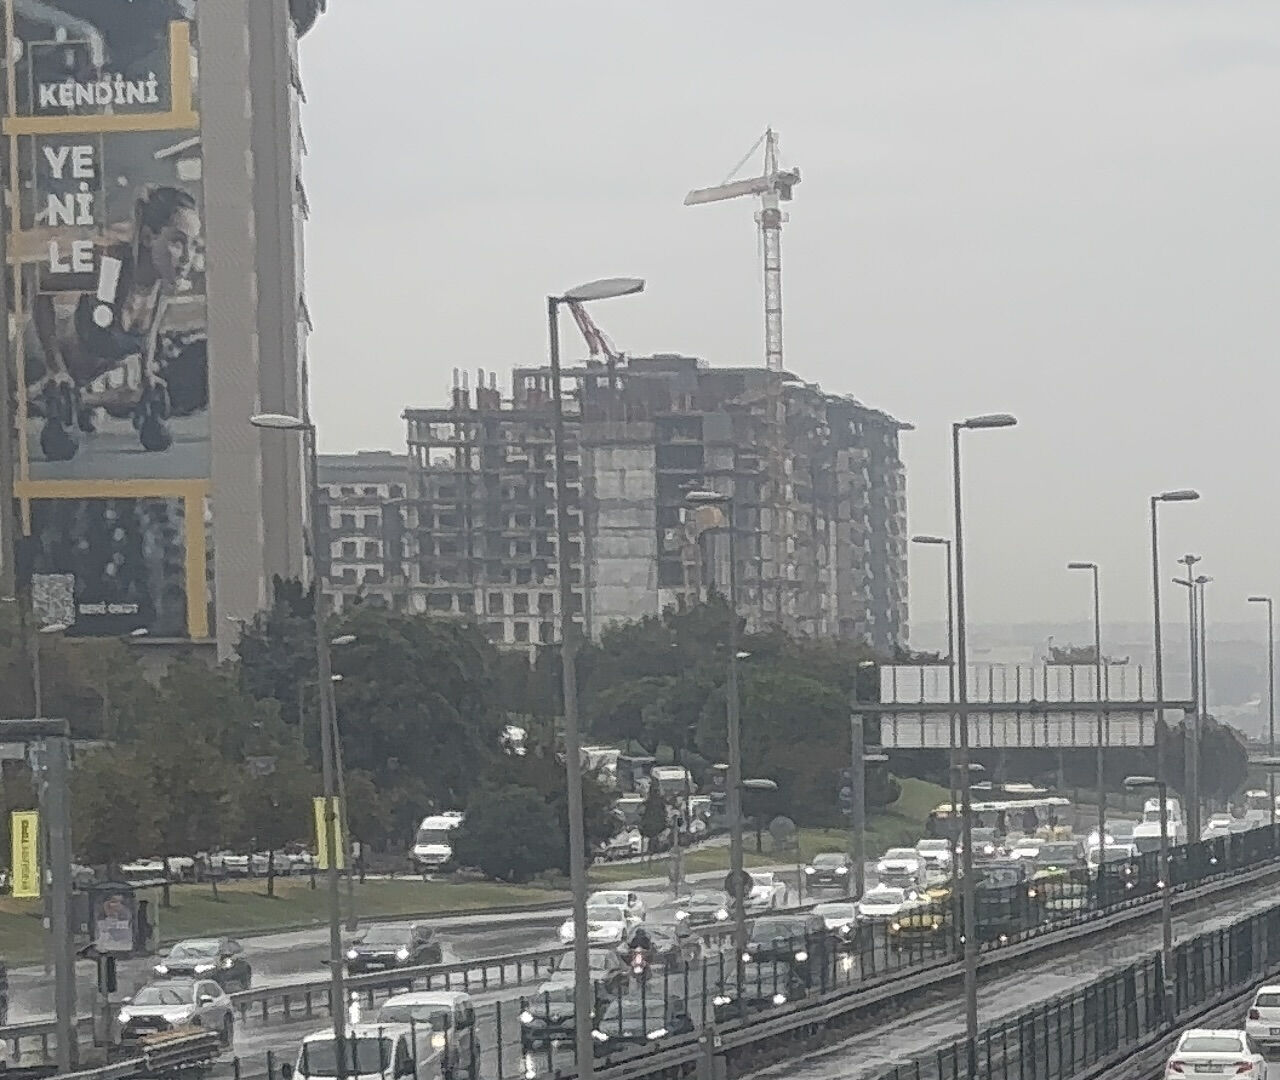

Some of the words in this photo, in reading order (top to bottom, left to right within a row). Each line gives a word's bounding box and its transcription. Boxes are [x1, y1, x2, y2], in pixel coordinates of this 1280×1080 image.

[39, 71, 159, 109] KENDİNİ
[42, 145, 95, 179] YE
[47, 181, 95, 227] Nİ
